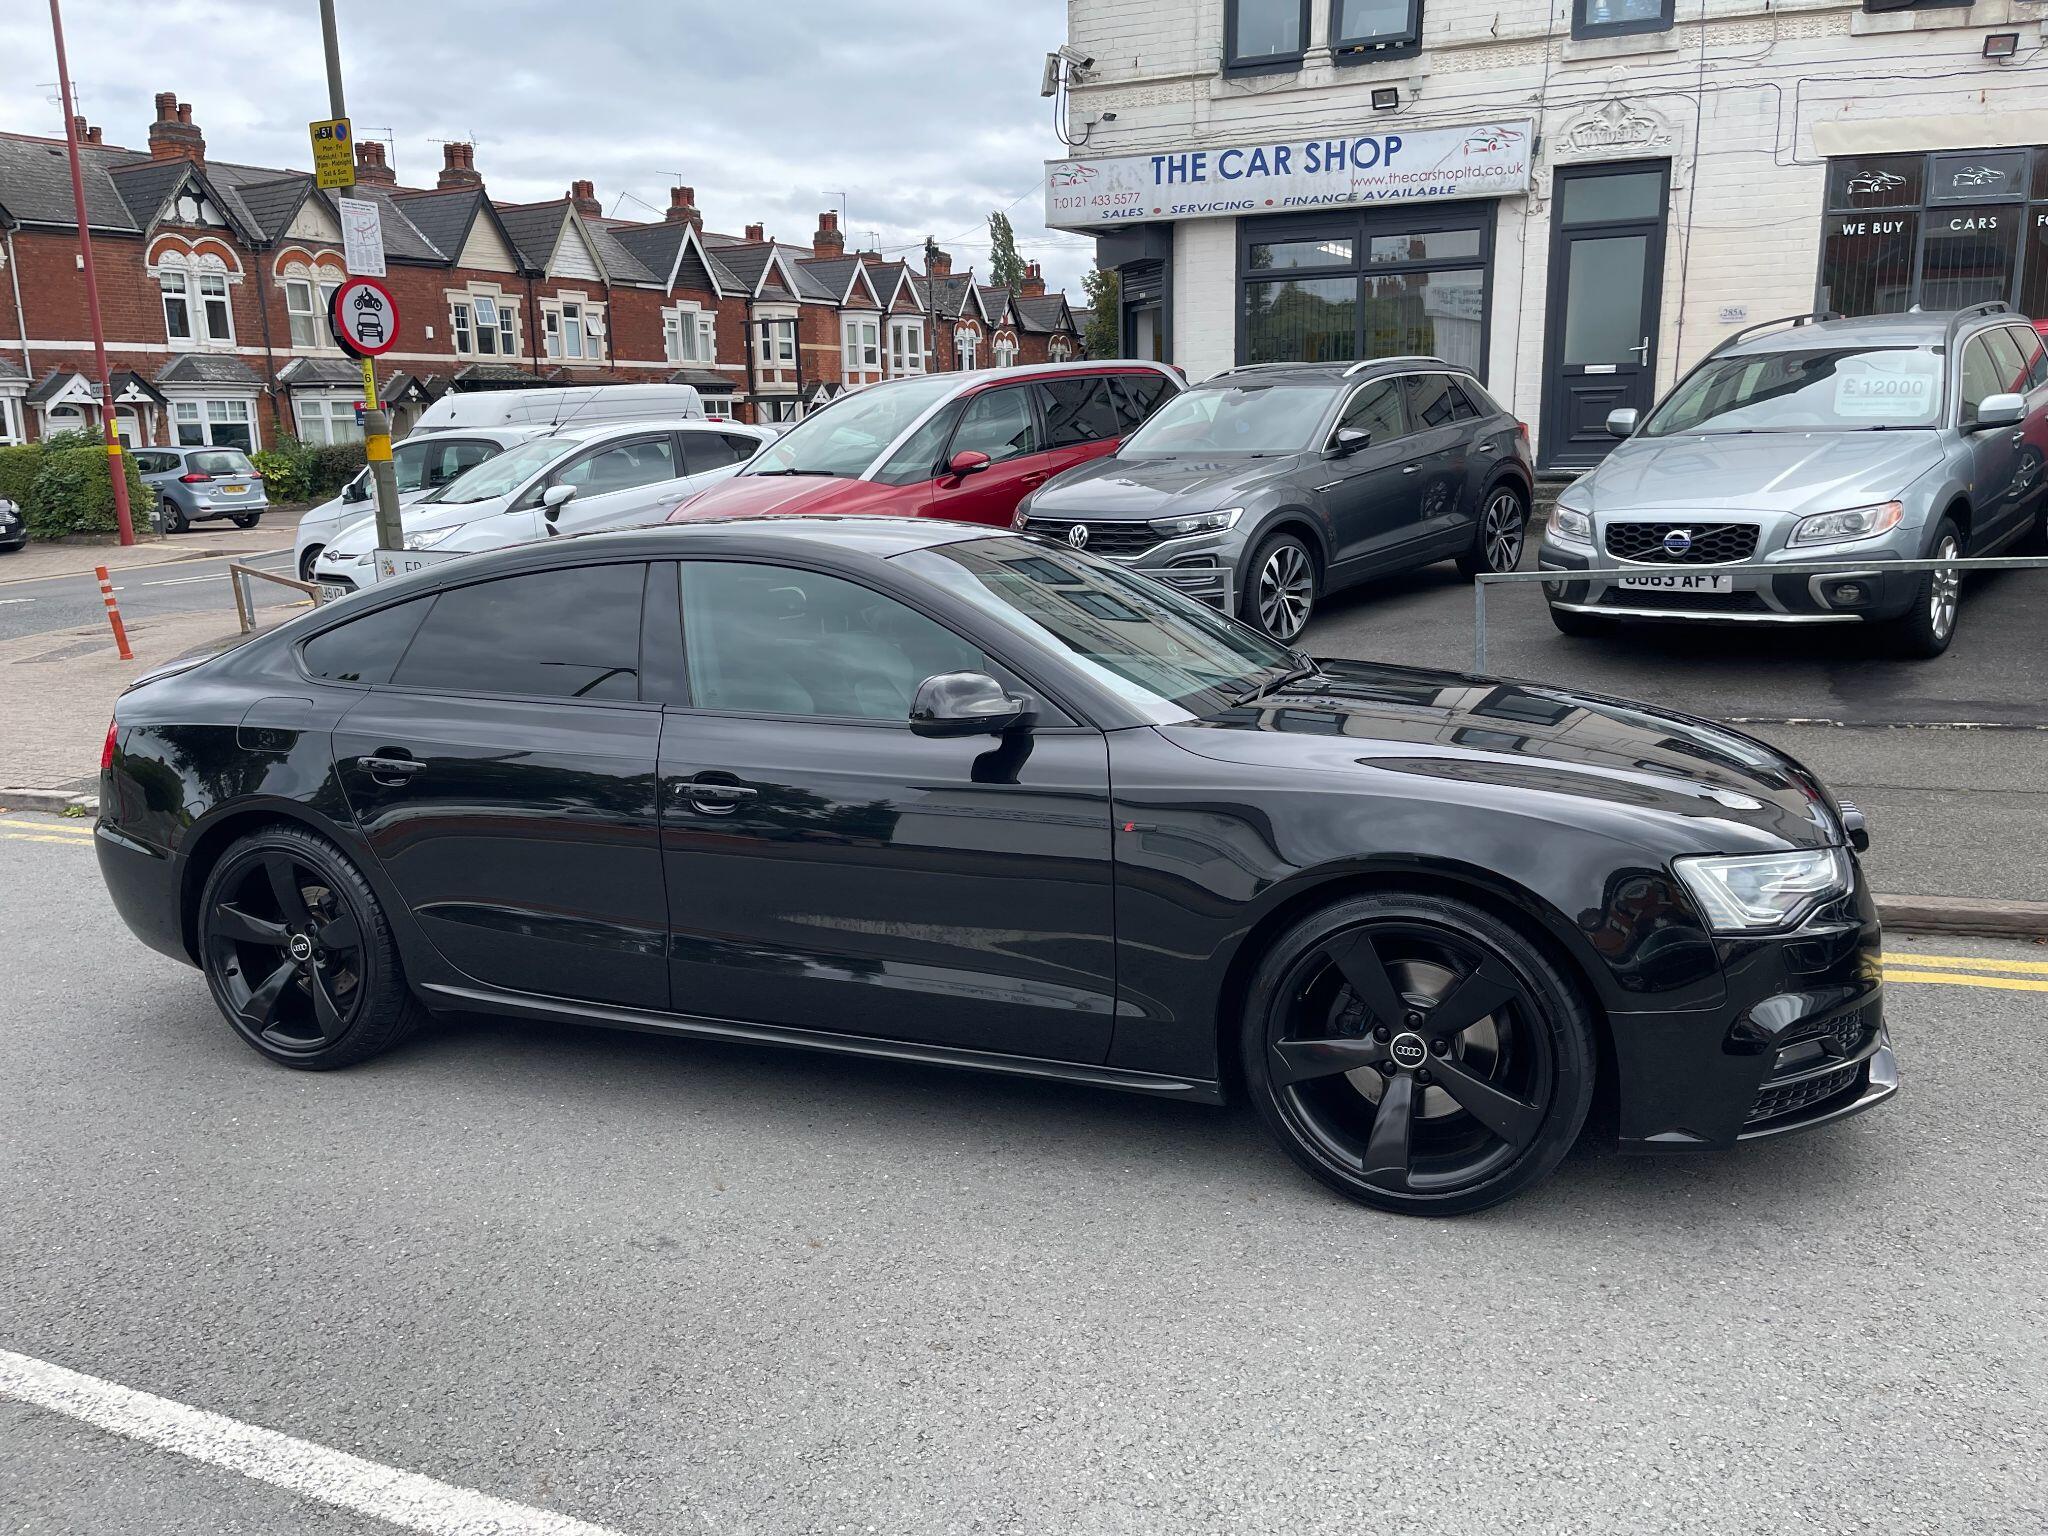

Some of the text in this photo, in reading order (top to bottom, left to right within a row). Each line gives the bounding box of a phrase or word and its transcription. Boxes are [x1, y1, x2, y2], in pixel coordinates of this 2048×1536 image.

[1152, 136, 1403, 185] THE CAR SHOP
[1351, 163, 1524, 187] www.thecarshopltd.co.uk
[1053, 192, 1141, 209] T:0121 433 5577
[1101, 184, 1456, 219] SALES SERVICING FINANCE AVAILABLE
[1842, 223, 1866, 236] WE
[1873, 221, 1904, 234] BUY
[1950, 216, 1998, 231] CARS
[365, 373, 371, 383] 6
